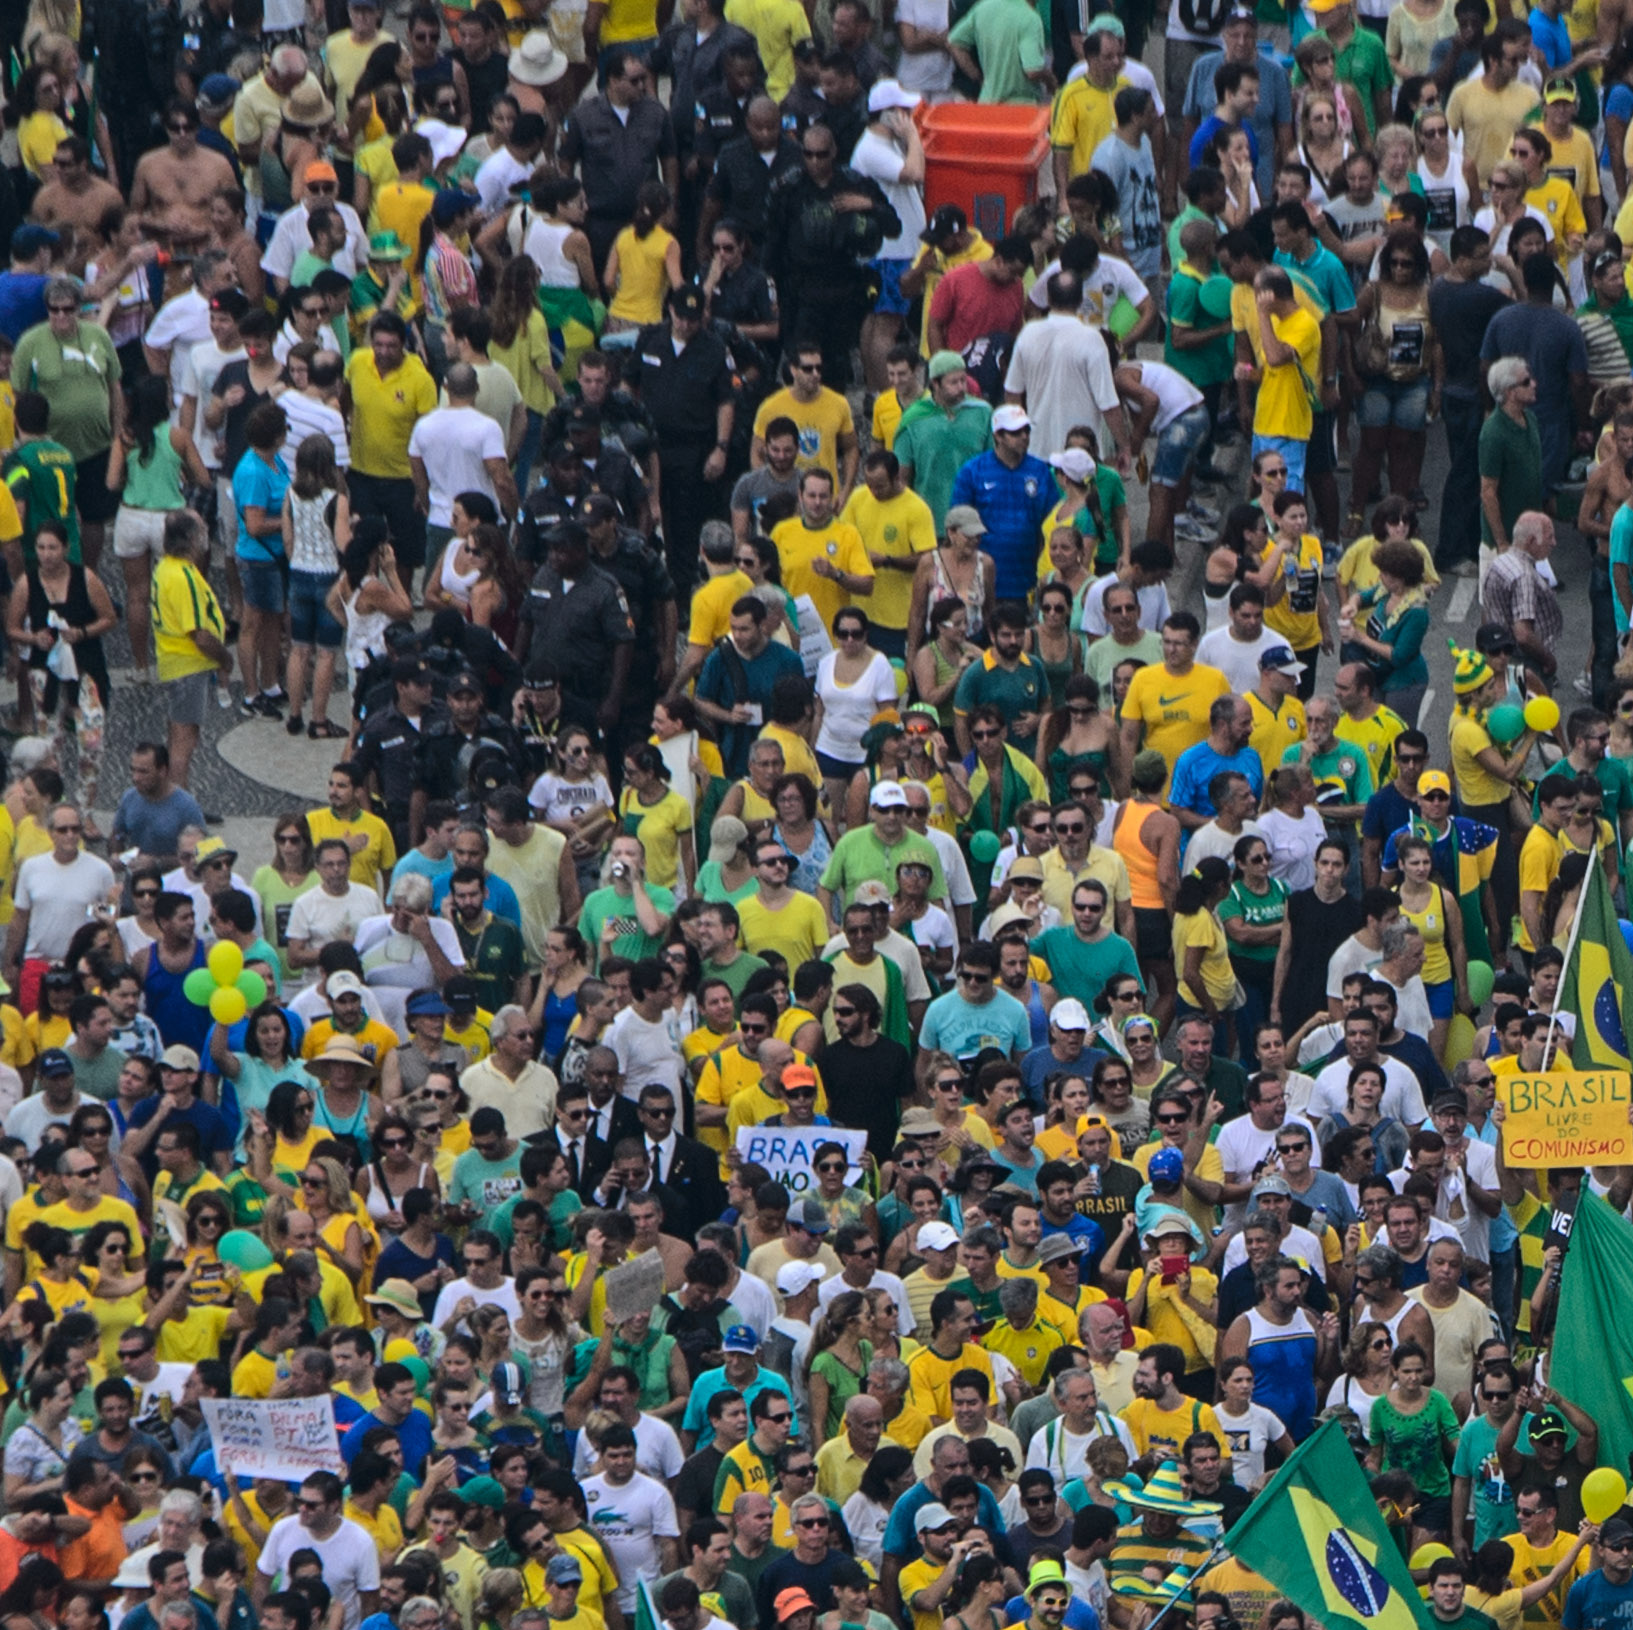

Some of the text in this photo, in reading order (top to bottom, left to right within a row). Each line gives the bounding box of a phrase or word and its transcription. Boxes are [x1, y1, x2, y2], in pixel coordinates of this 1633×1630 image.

[1509, 1074, 1627, 1114] BRASIL
[1546, 1111, 1593, 1127] LIVRE
[1556, 1126, 1580, 1139] DO
[1509, 1136, 1625, 1160] COMUNISMO
